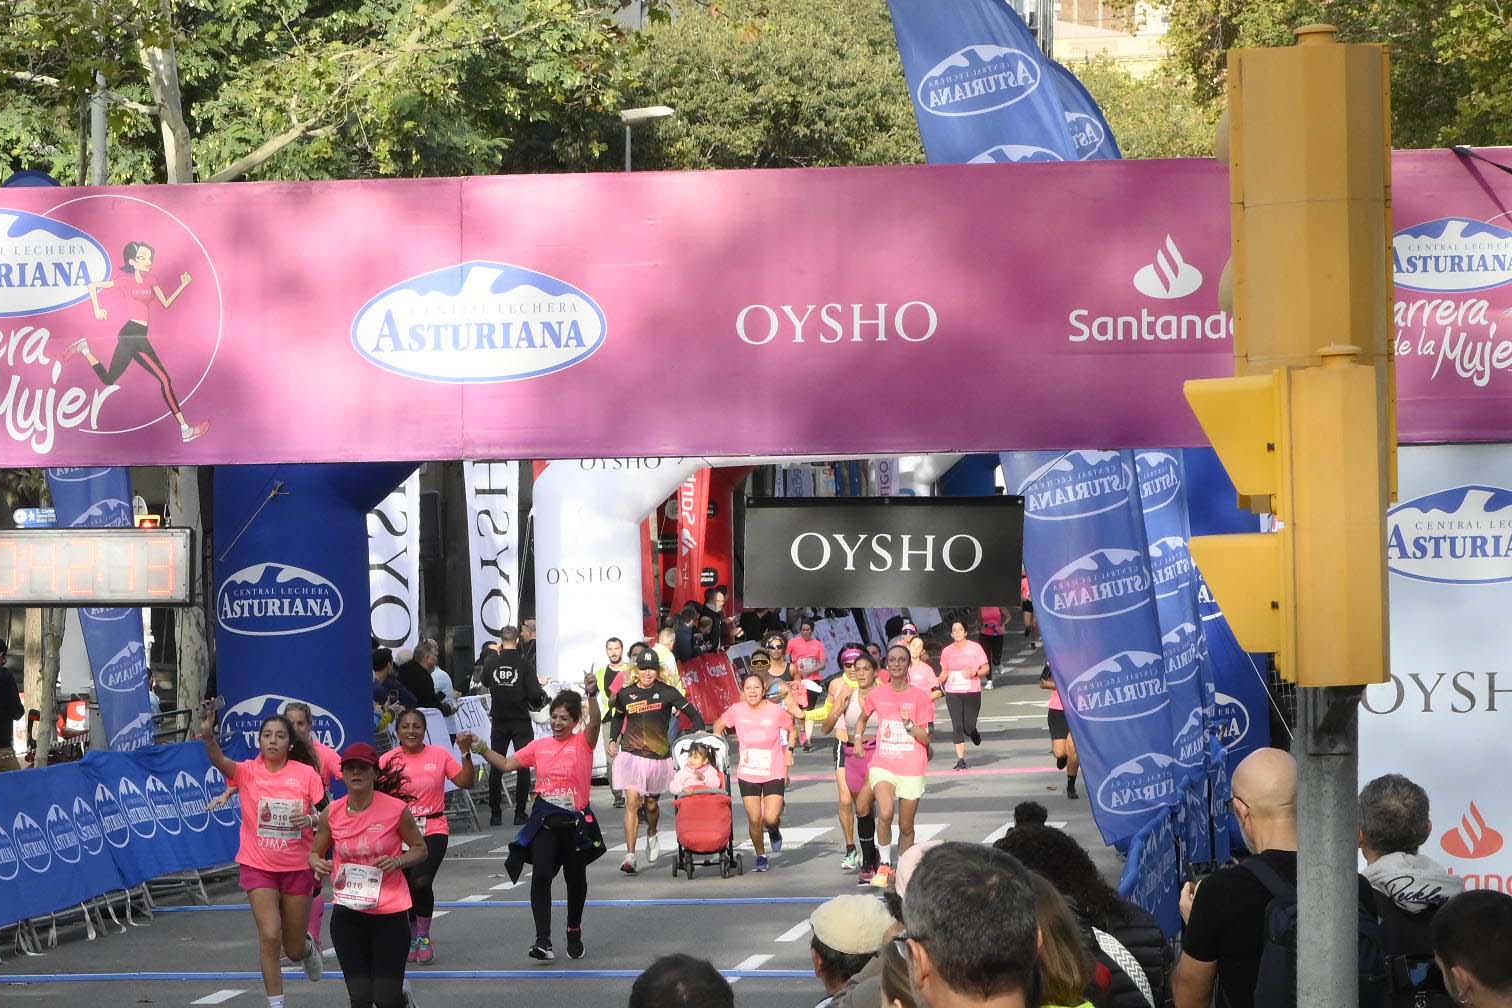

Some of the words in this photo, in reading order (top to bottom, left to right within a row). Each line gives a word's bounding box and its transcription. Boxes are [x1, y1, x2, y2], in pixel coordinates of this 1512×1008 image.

[14, 244, 86, 256] LECHERA
[1409, 241, 1458, 252] CENTRAL
[498, 302, 579, 314] LECHERA
[1394, 298, 1490, 328] arrera
[372, 308, 587, 353] ASTURIANA
[736, 301, 938, 346] OYSHO
[1418, 328, 1435, 356] la
[1415, 520, 1482, 531] CENTRAL
[789, 532, 984, 573] OYSHO
[546, 565, 622, 585] OYSHO
[220, 579, 333, 620] ASTURIANA
[234, 586, 277, 597] CENTRAL
[499, 671, 513, 680] BP
